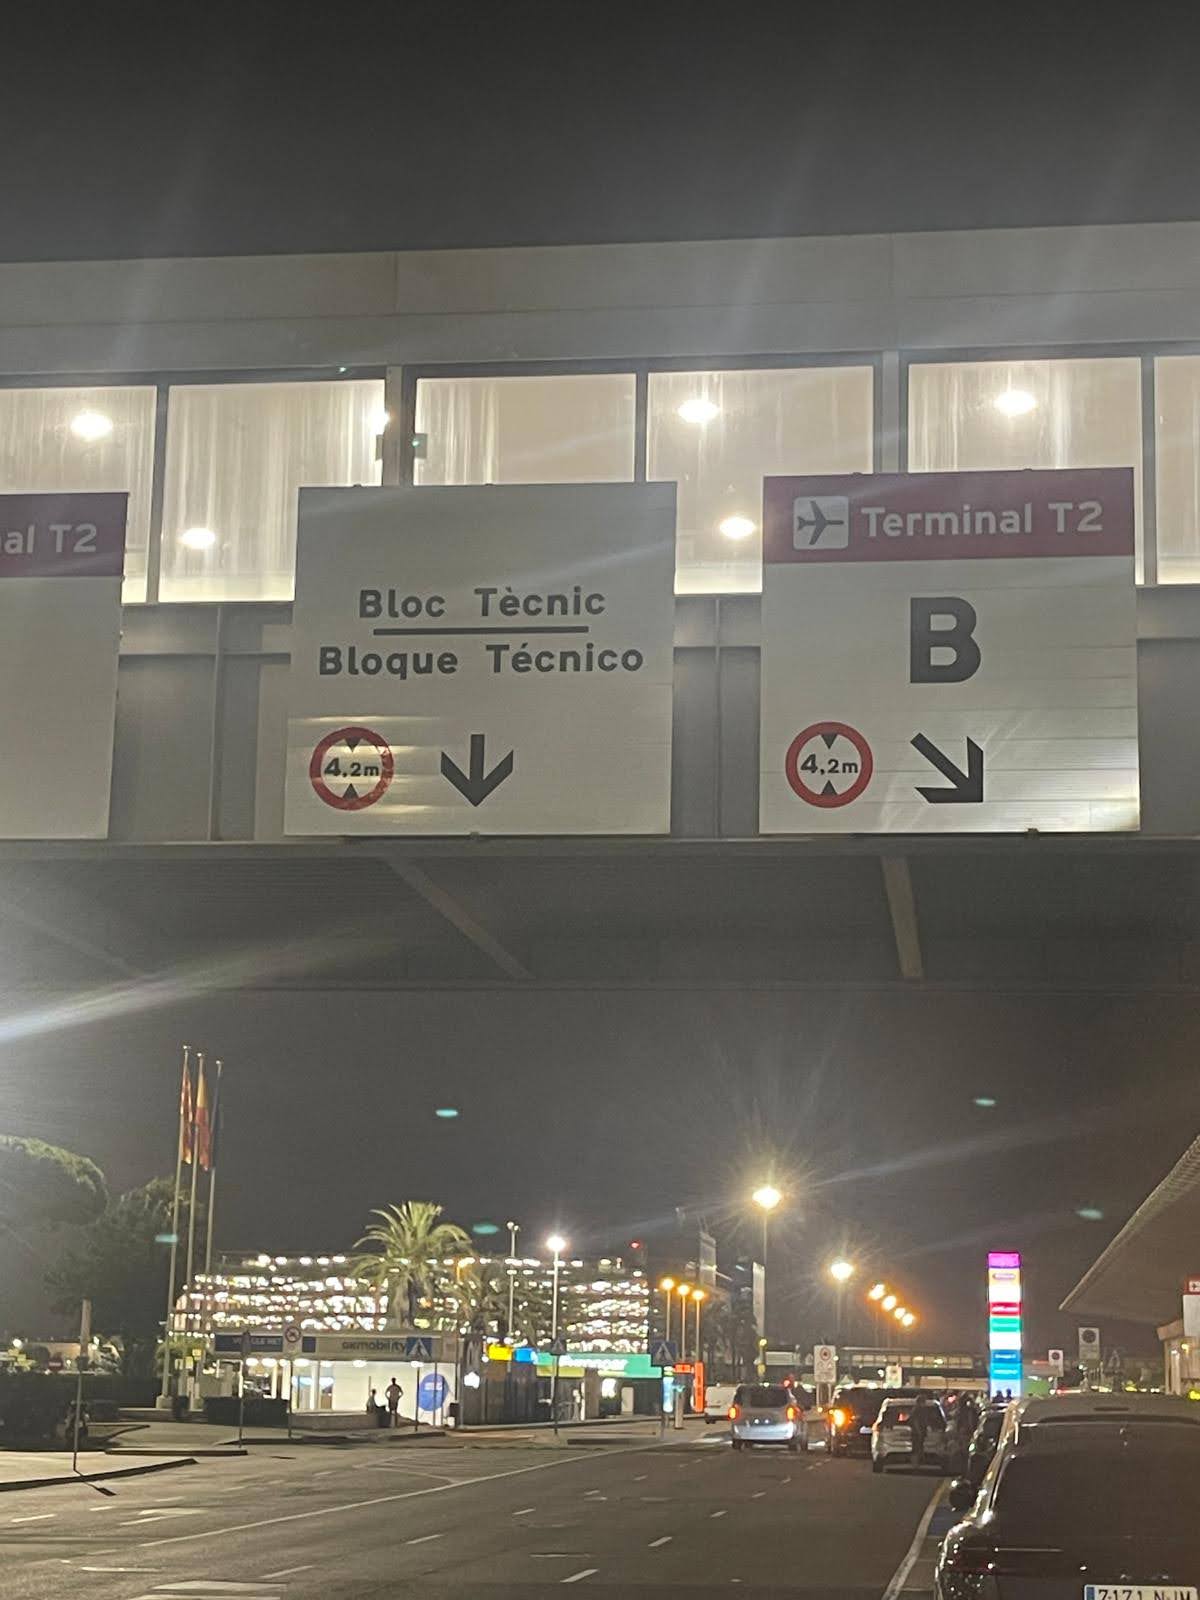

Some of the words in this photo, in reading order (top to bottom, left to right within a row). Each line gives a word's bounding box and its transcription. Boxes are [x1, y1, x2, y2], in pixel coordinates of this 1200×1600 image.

[861, 503, 1033, 537] Terminal
[1048, 500, 1104, 533] T2
[0, 524, 36, 554] al
[48, 523, 97, 553] T2
[358, 587, 447, 619] Bloc
[473, 586, 607, 618] Tècnic
[909, 596, 982, 684] B
[319, 645, 459, 681] Bloque
[485, 642, 644, 674] Técnico
[801, 753, 859, 776] 4,2m
